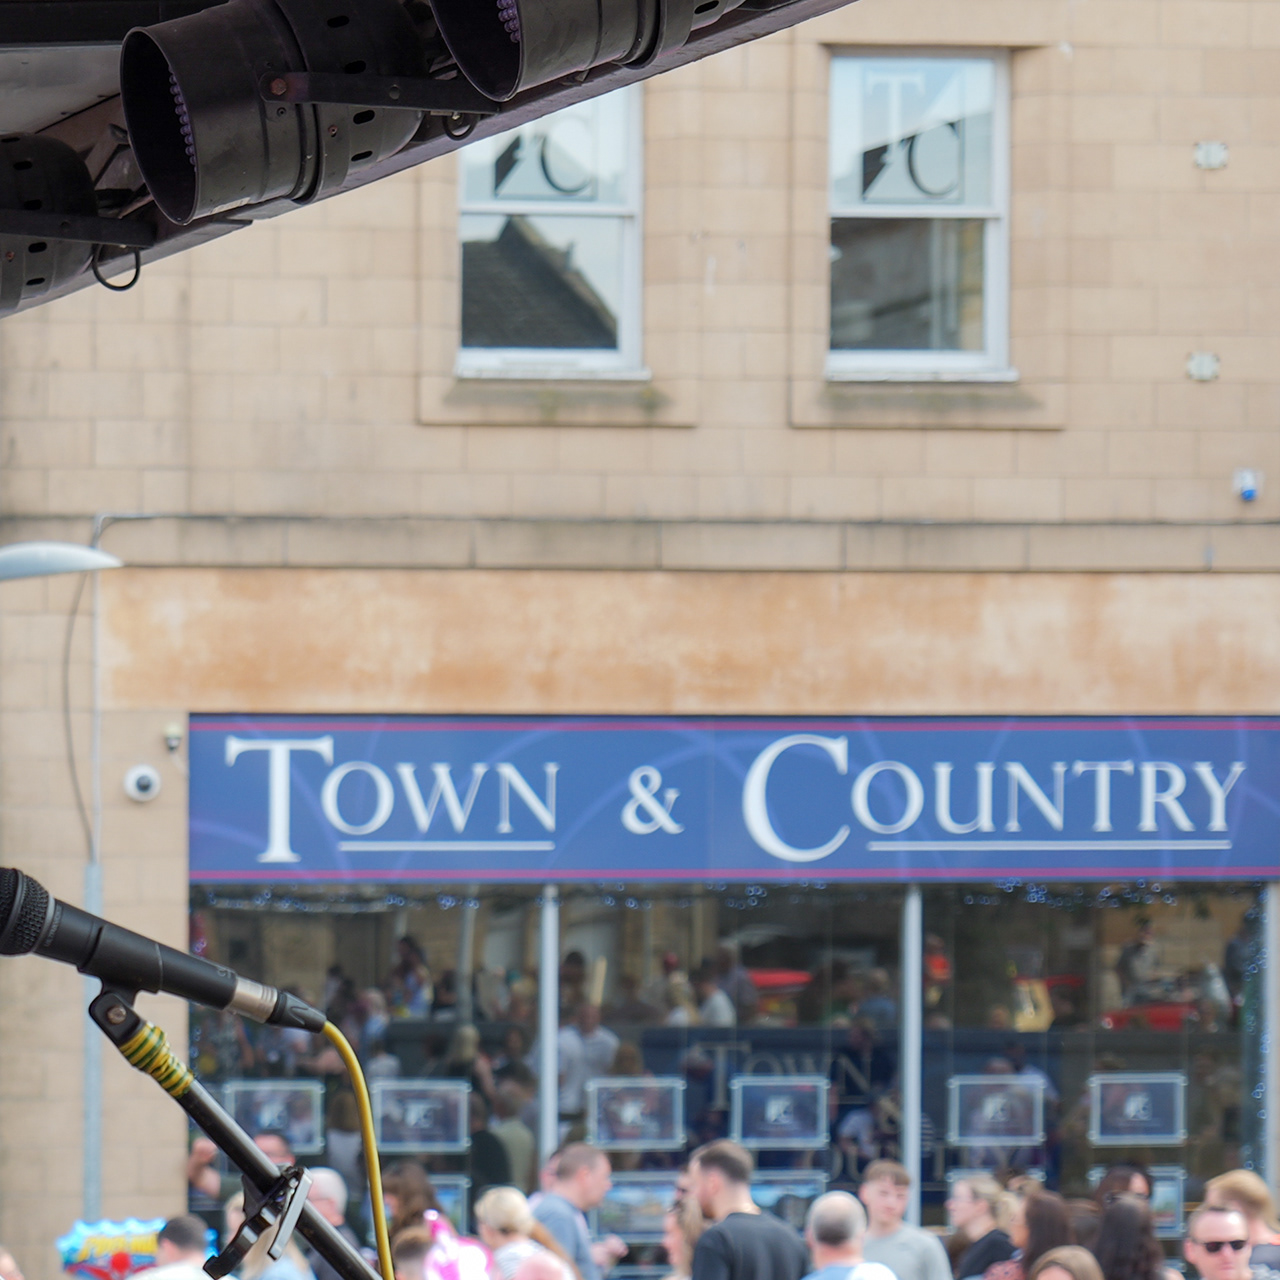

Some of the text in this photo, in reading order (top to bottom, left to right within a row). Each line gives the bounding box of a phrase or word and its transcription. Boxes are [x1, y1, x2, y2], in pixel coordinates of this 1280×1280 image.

[225, 733, 1247, 863] TOWN & COUNTRY
